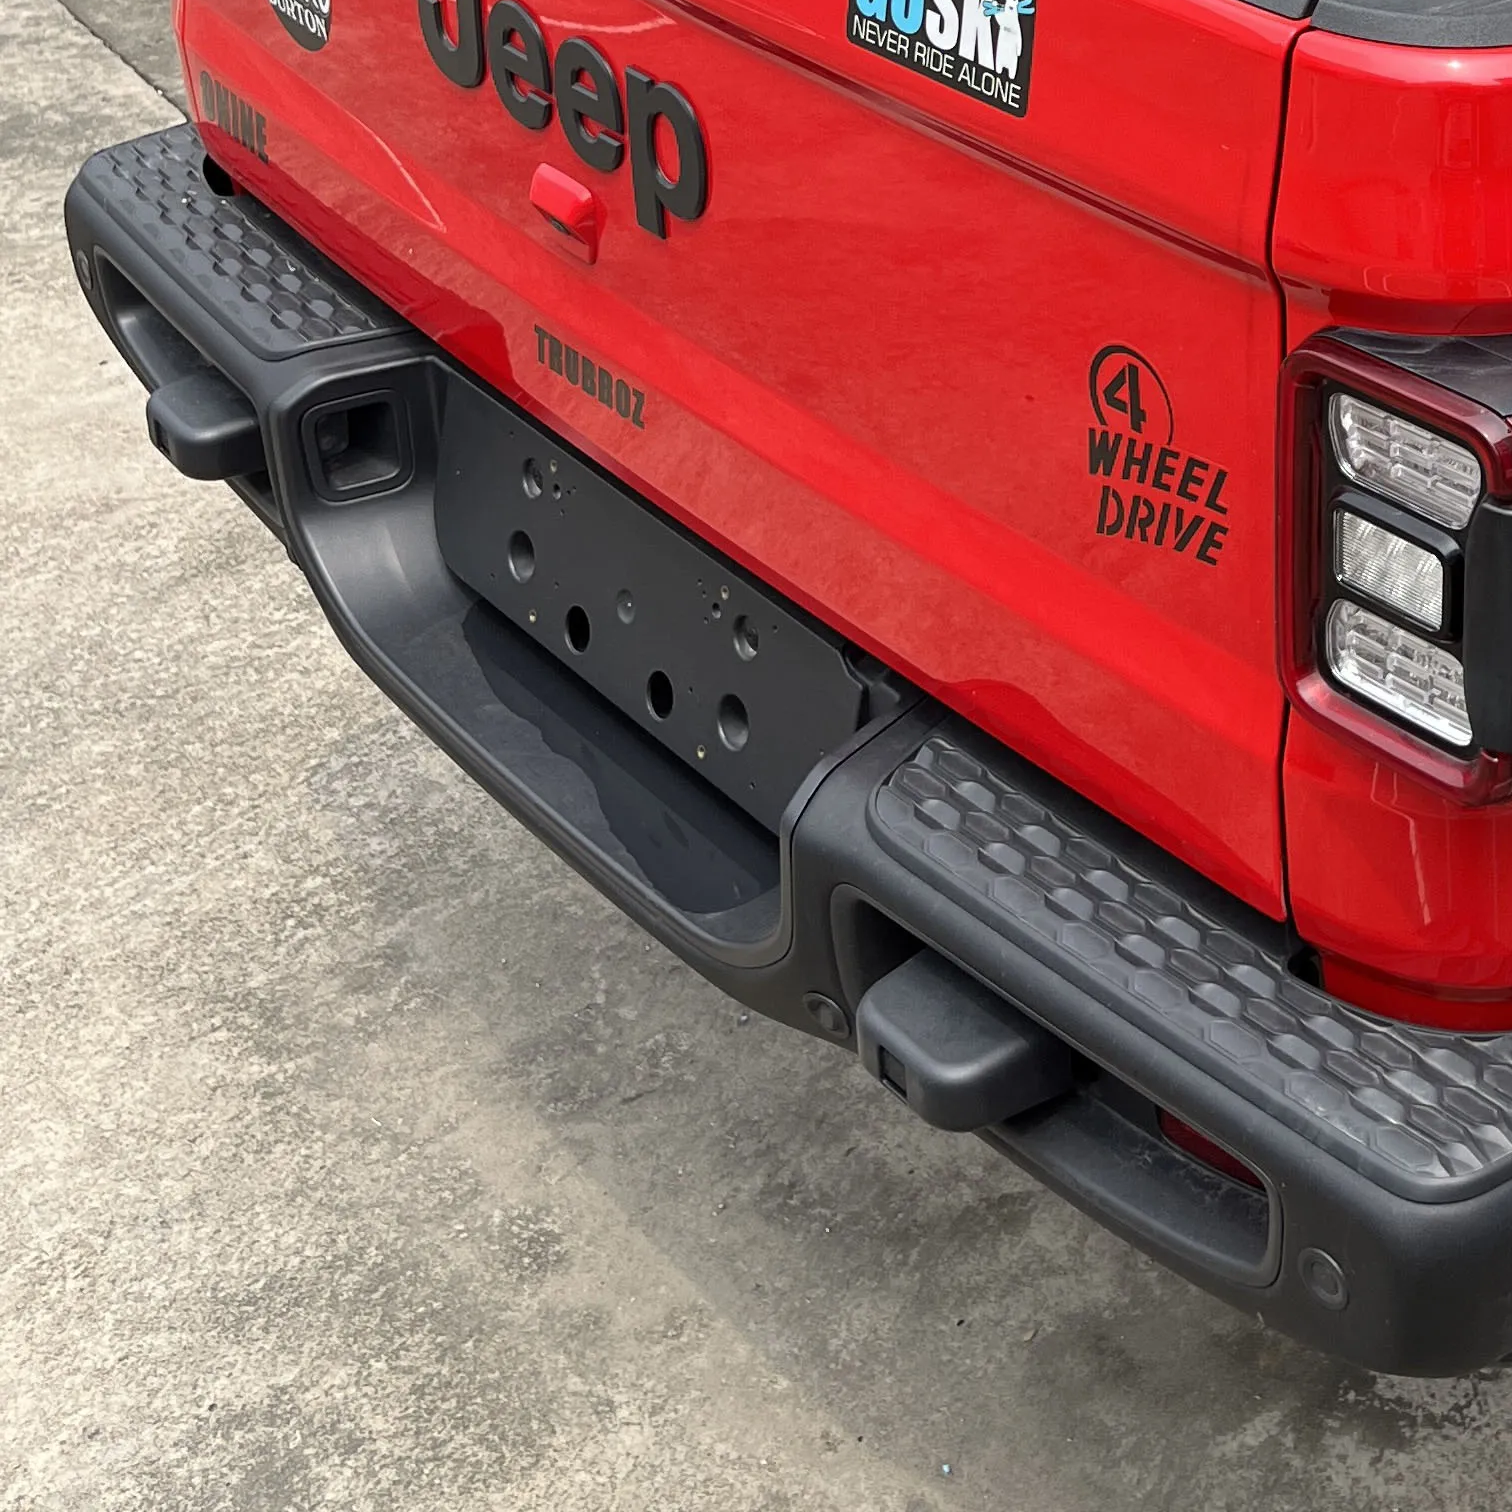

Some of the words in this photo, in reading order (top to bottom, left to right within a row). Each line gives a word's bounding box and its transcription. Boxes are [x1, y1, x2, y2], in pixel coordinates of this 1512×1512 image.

[853, 14, 909, 58] NEVER
[914, 41, 955, 79] RIDE
[958, 63, 1022, 109] ALONE
[1102, 362, 1147, 434] 4
[1088, 427, 1229, 515] WHEEL
[1096, 485, 1229, 566] DRIVE
